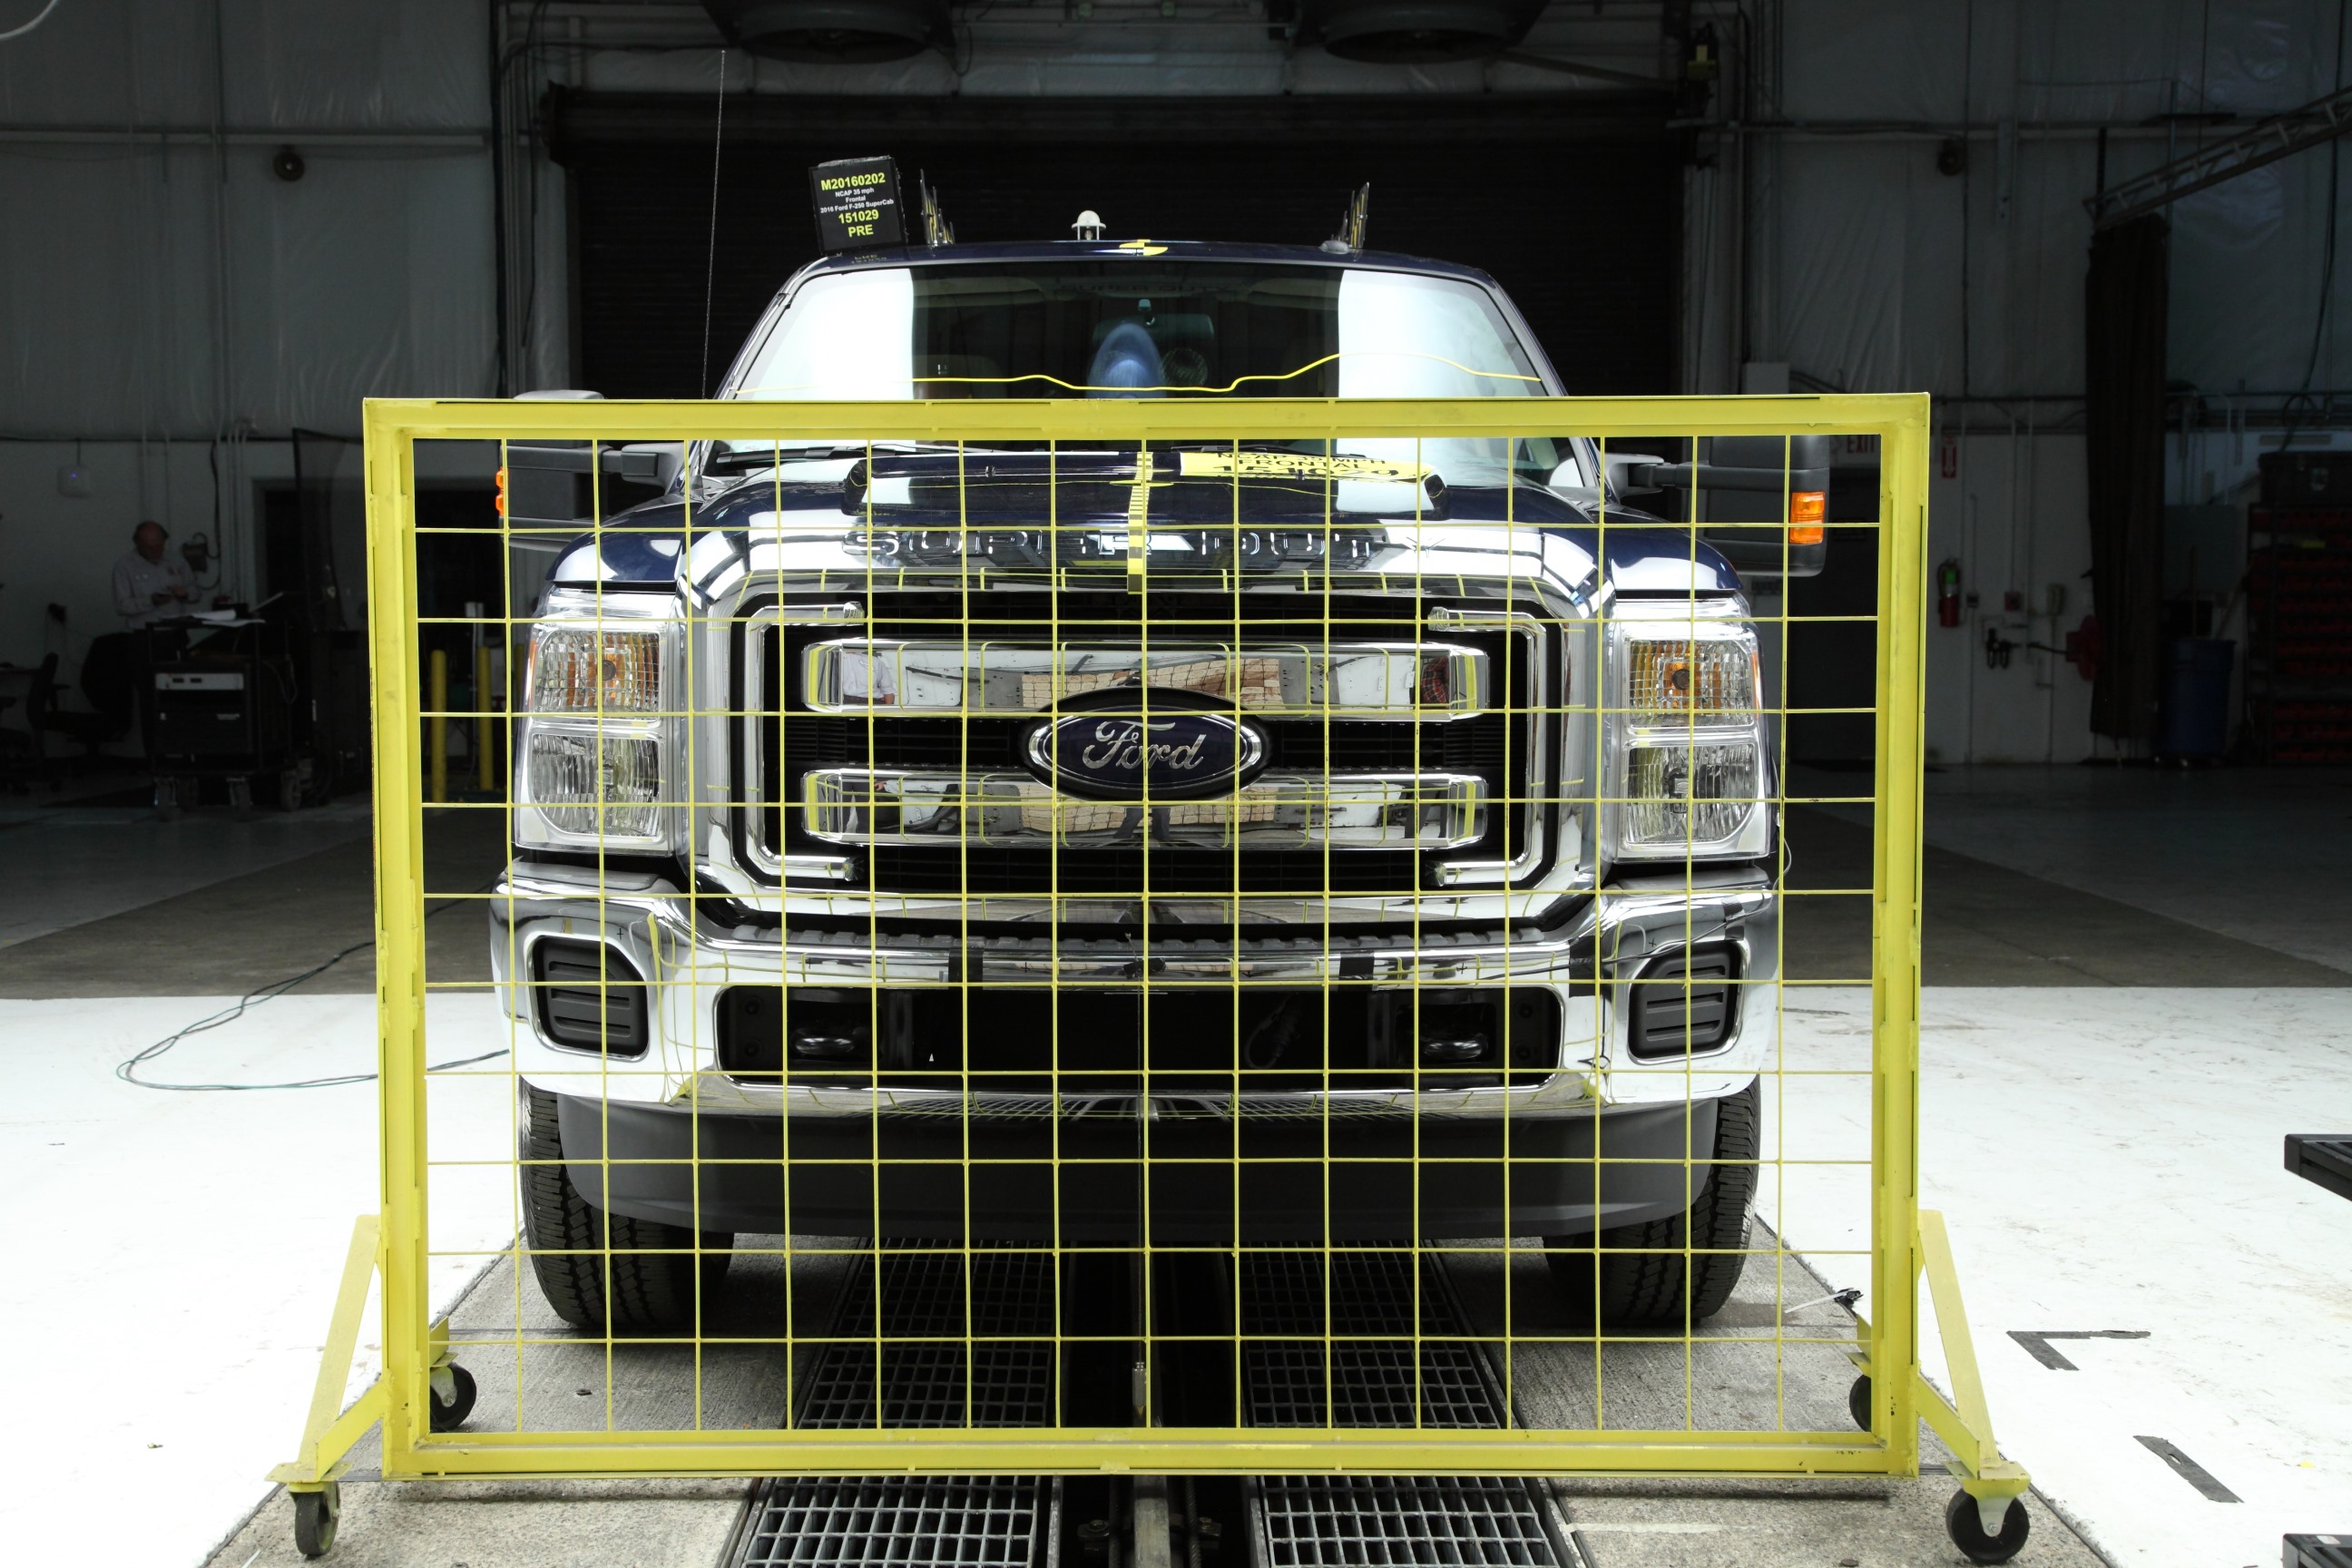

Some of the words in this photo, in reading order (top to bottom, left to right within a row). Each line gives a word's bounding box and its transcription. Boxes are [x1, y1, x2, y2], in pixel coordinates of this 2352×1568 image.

[820, 172, 886, 191] M20160202
[861, 187, 875, 195] mph
[866, 199, 894, 208] SuperCab
[838, 209, 879, 224] 151029
[848, 224, 874, 238] PRE
[1238, 460, 1365, 469] FRONTAL
[843, 530, 1152, 556] SUPER
[1082, 720, 1207, 769] Ford
